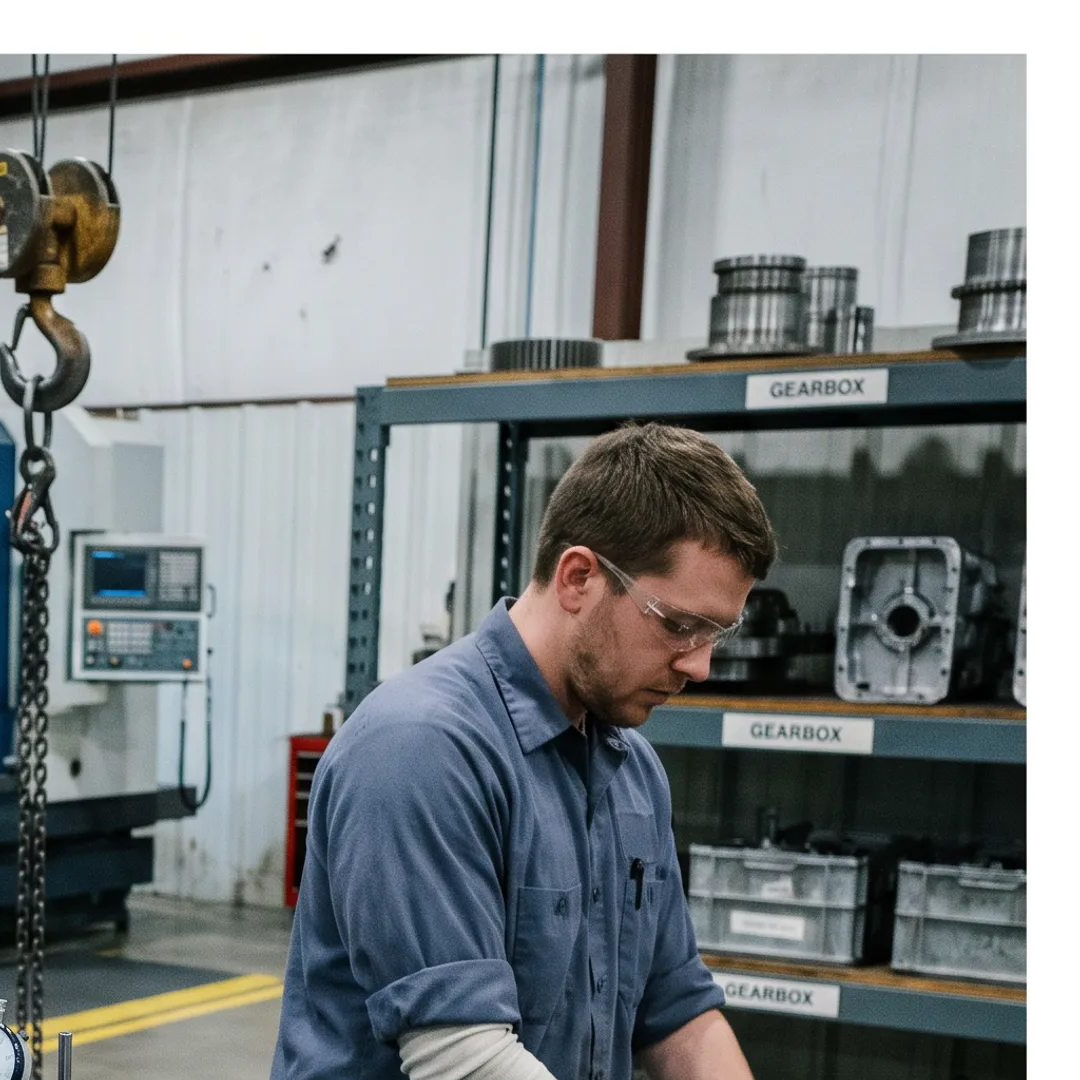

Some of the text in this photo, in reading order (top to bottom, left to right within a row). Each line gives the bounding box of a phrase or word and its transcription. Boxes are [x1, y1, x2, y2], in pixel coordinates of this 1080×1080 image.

[770, 378, 865, 398] GEARBOX
[750, 722, 842, 742] GEARBOX
[725, 982, 814, 1006] GEARBOX
